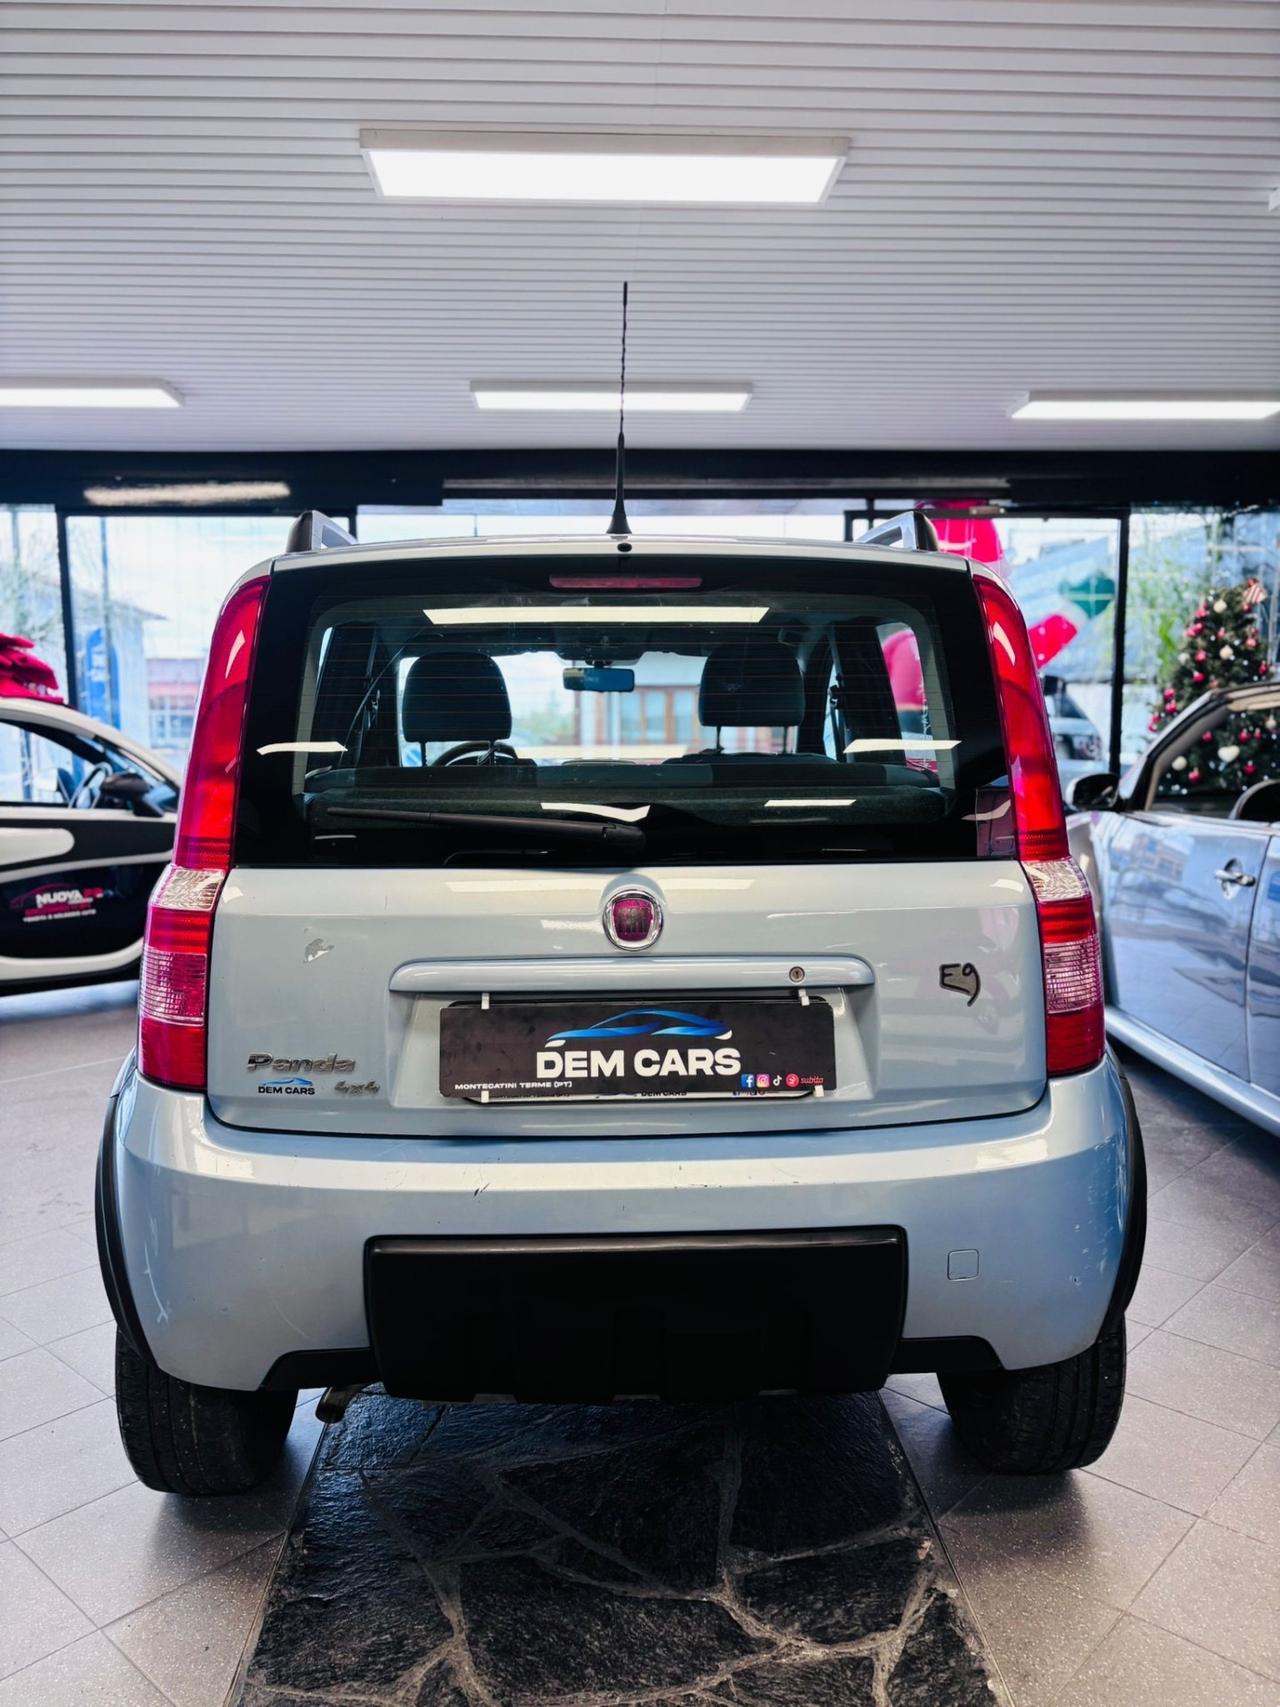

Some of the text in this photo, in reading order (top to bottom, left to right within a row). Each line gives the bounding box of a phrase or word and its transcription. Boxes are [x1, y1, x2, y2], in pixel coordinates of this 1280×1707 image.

[247, 1051, 356, 1073] Panda
[536, 1048, 741, 1078] DEM CARS
[258, 1086, 315, 1095] DEM CARS
